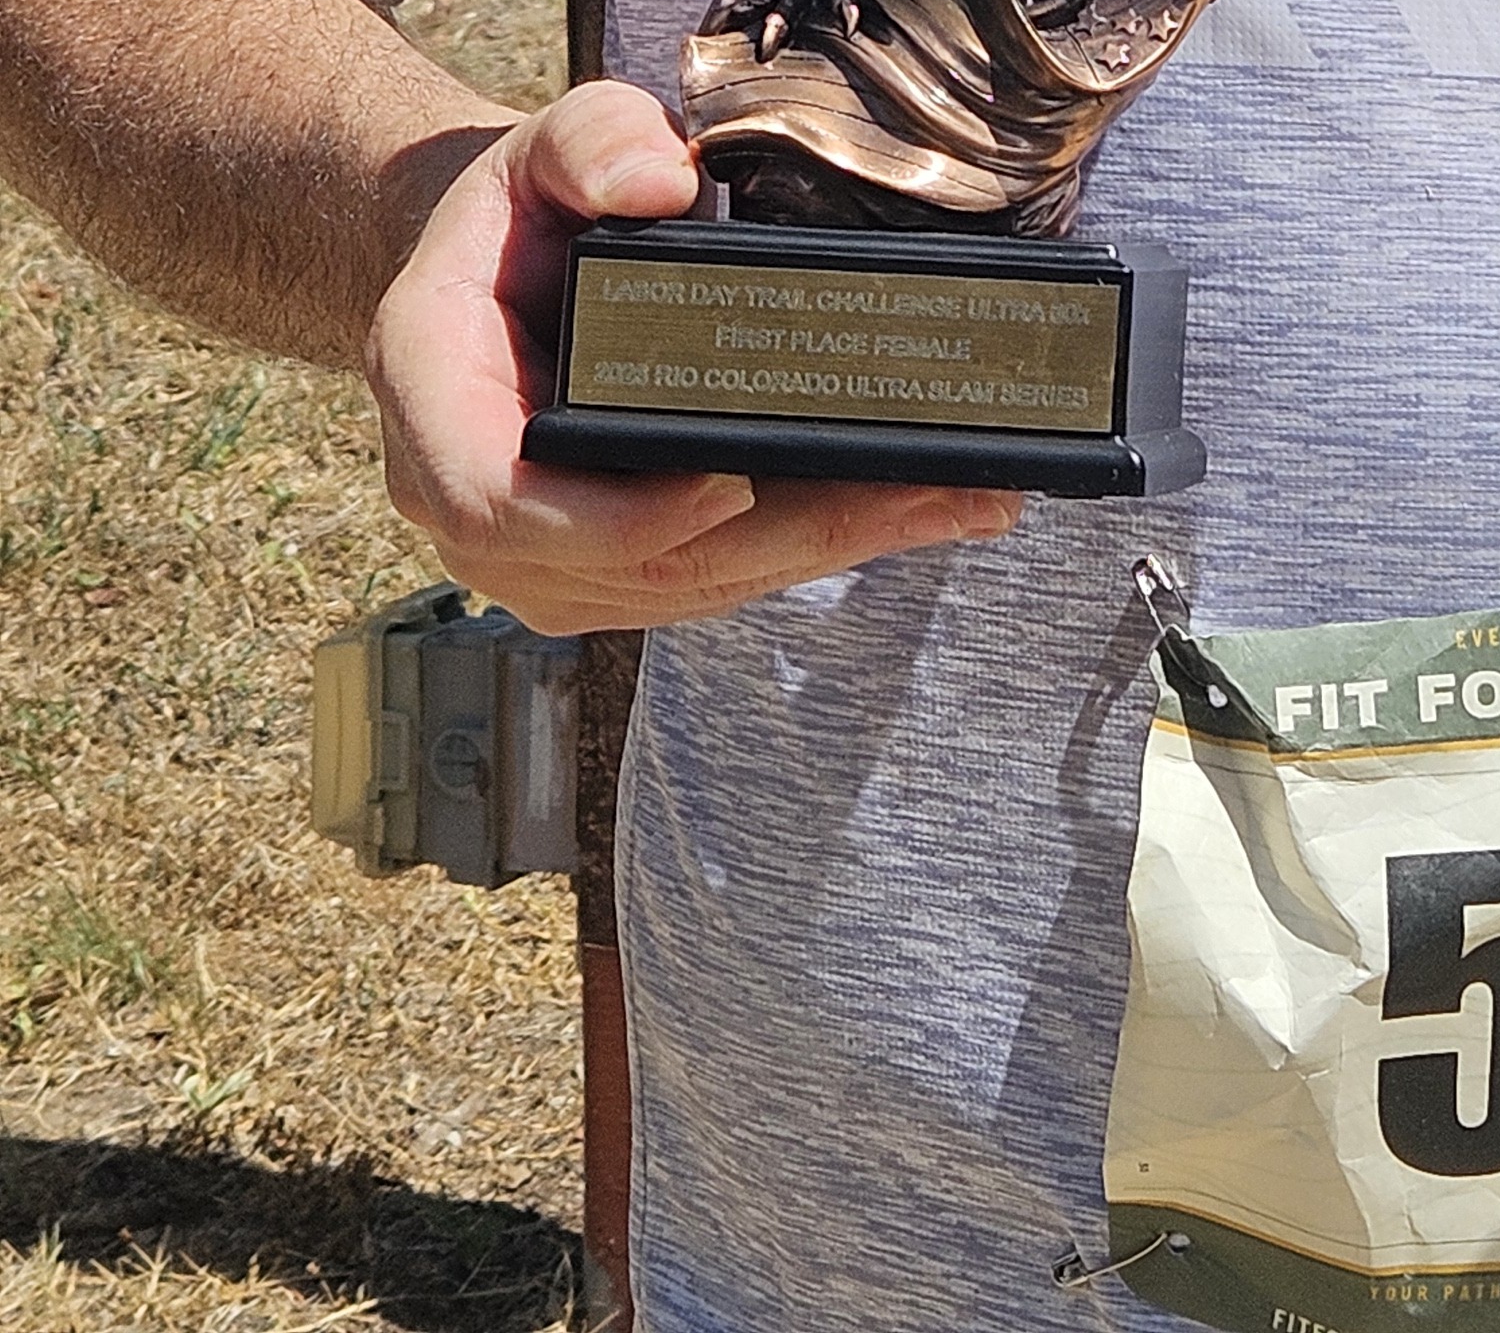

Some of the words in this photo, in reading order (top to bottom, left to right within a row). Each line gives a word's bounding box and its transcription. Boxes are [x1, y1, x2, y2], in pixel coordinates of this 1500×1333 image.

[603, 278, 685, 305] LABOR
[690, 282, 740, 307] DAY
[816, 289, 962, 319] CHALLENGE
[967, 296, 1046, 323] ULTRA
[715, 325, 786, 350] FIRST
[790, 330, 868, 355] PLACE
[874, 336, 972, 360] FEMALE
[654, 364, 699, 387] RIO
[703, 367, 841, 396] COLORADO
[846, 375, 924, 401] ULTRA
[928, 379, 994, 404] SLAM
[1000, 383, 1090, 410] SERIES
[1273, 678, 1388, 733] FIT
[1368, 1285, 1428, 1302] YOUR
